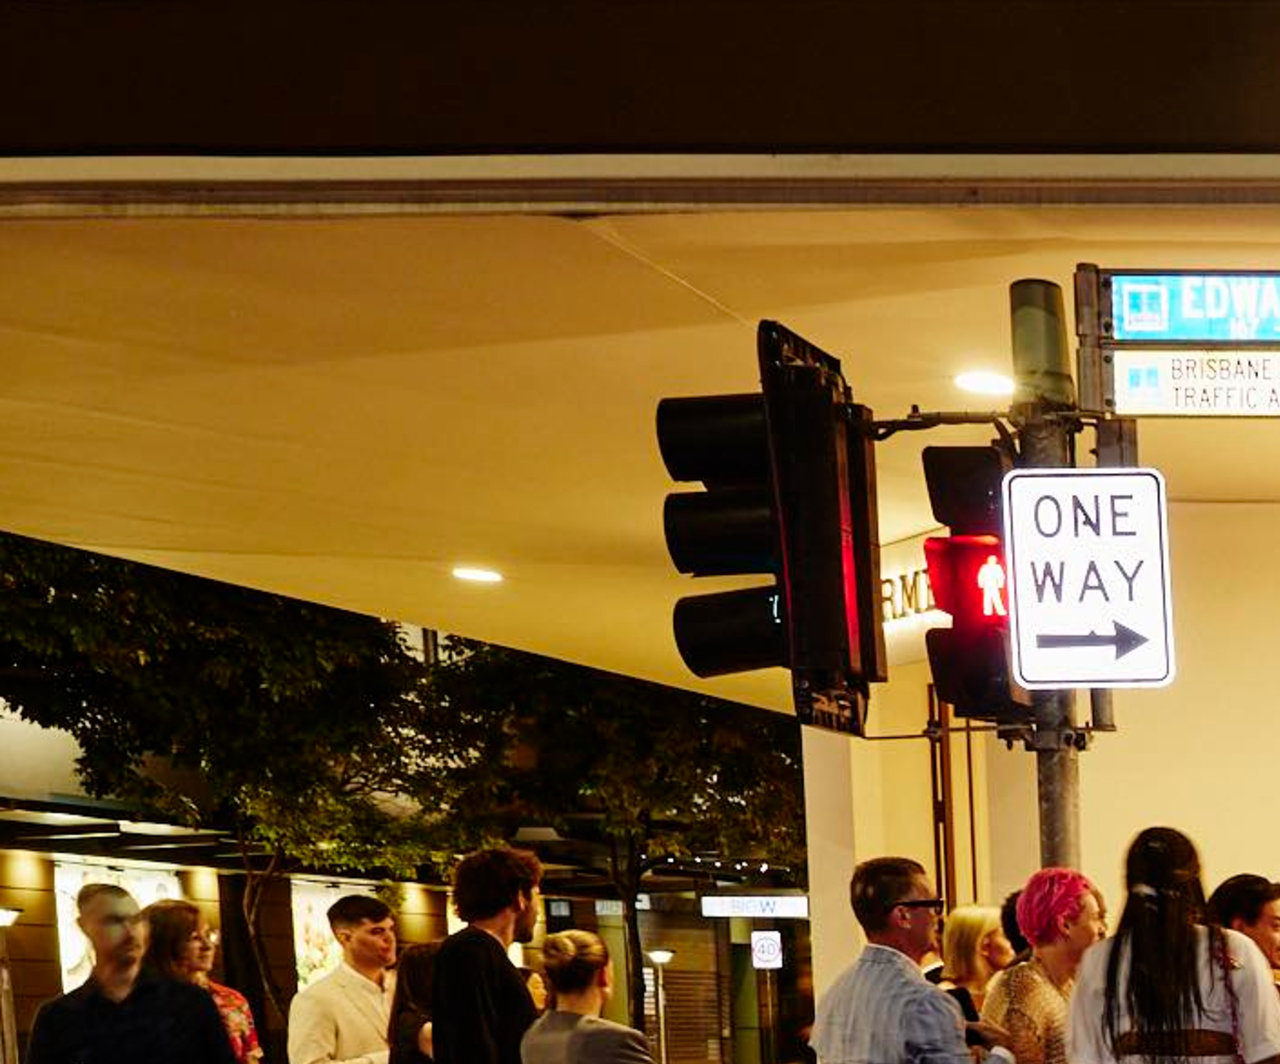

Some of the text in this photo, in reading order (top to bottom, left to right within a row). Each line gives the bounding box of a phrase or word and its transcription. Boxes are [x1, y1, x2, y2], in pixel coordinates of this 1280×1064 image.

[1171, 358, 1272, 381] BRISBANE
[1172, 387, 1258, 409] TRAFFIC
[1033, 494, 1137, 538] ONE
[1030, 559, 1145, 603] WAY
[757, 942, 777, 956] 40
